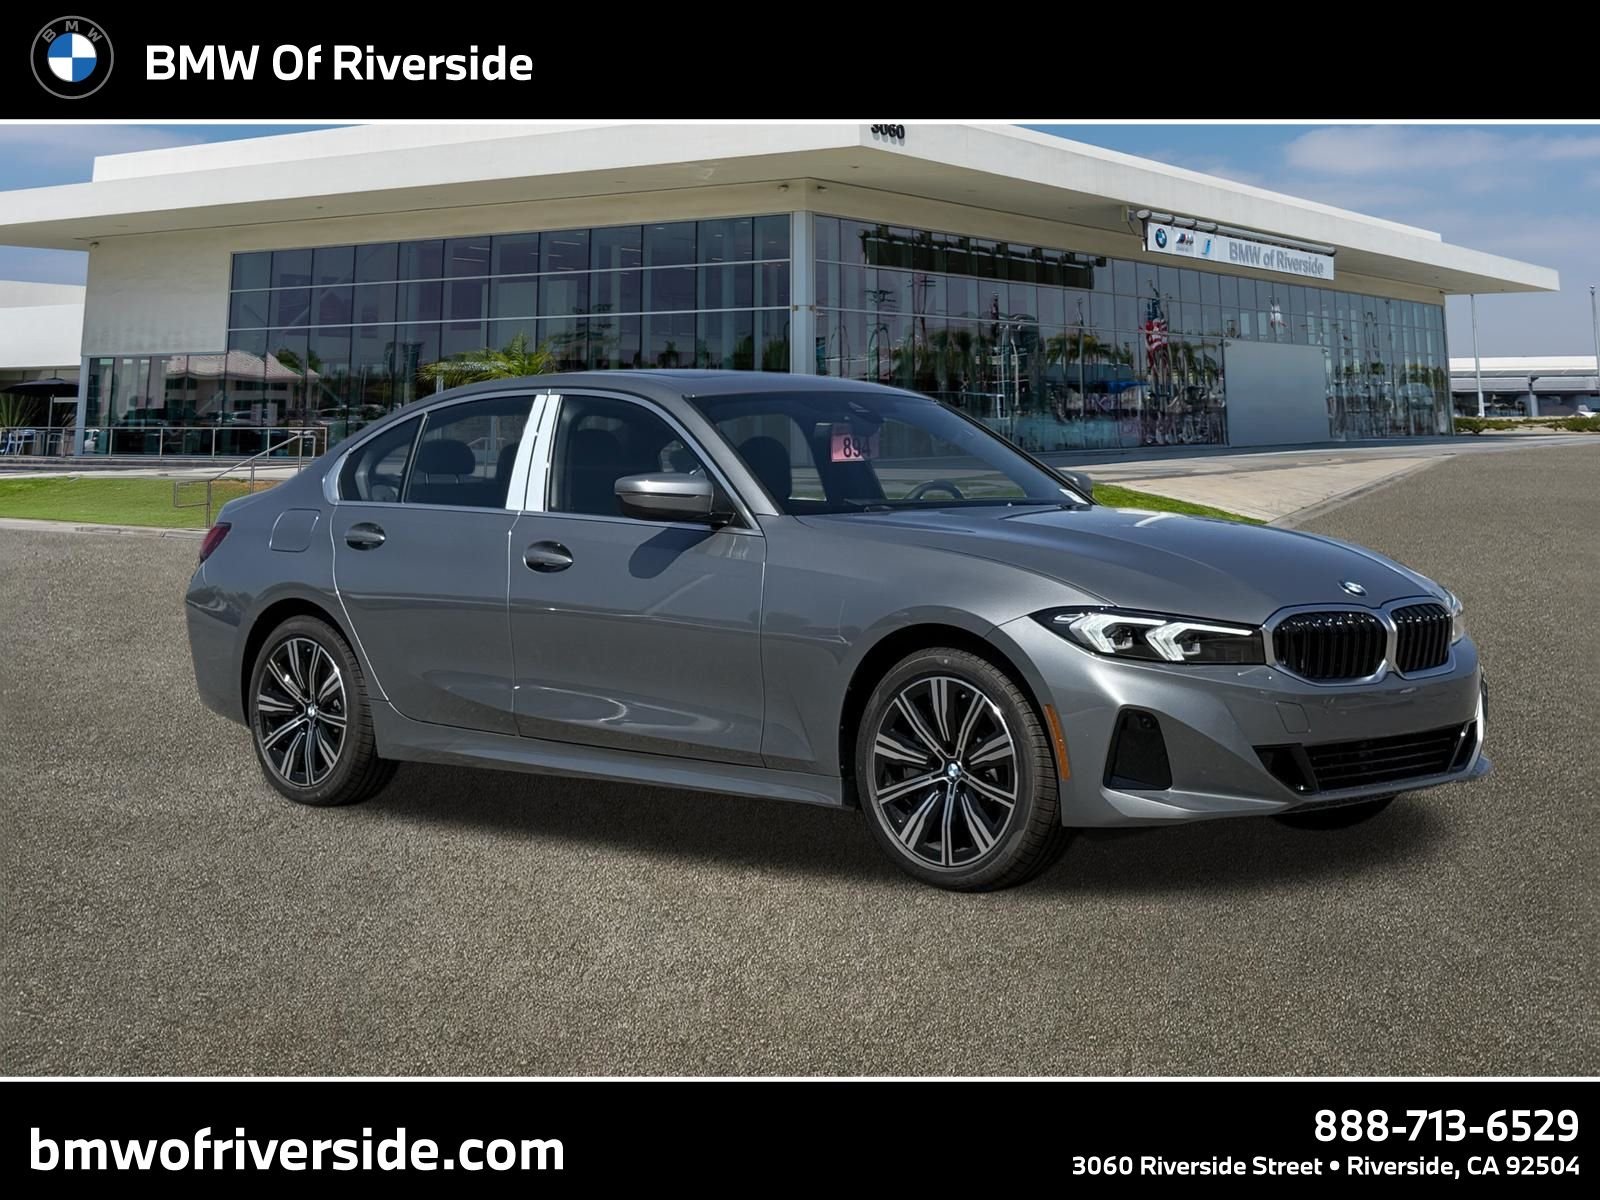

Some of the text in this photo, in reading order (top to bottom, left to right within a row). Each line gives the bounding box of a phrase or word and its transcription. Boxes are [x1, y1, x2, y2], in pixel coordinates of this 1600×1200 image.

[1229, 241, 1261, 265] BMW
[1263, 249, 1275, 269] of
[1276, 250, 1324, 275] Riverside
